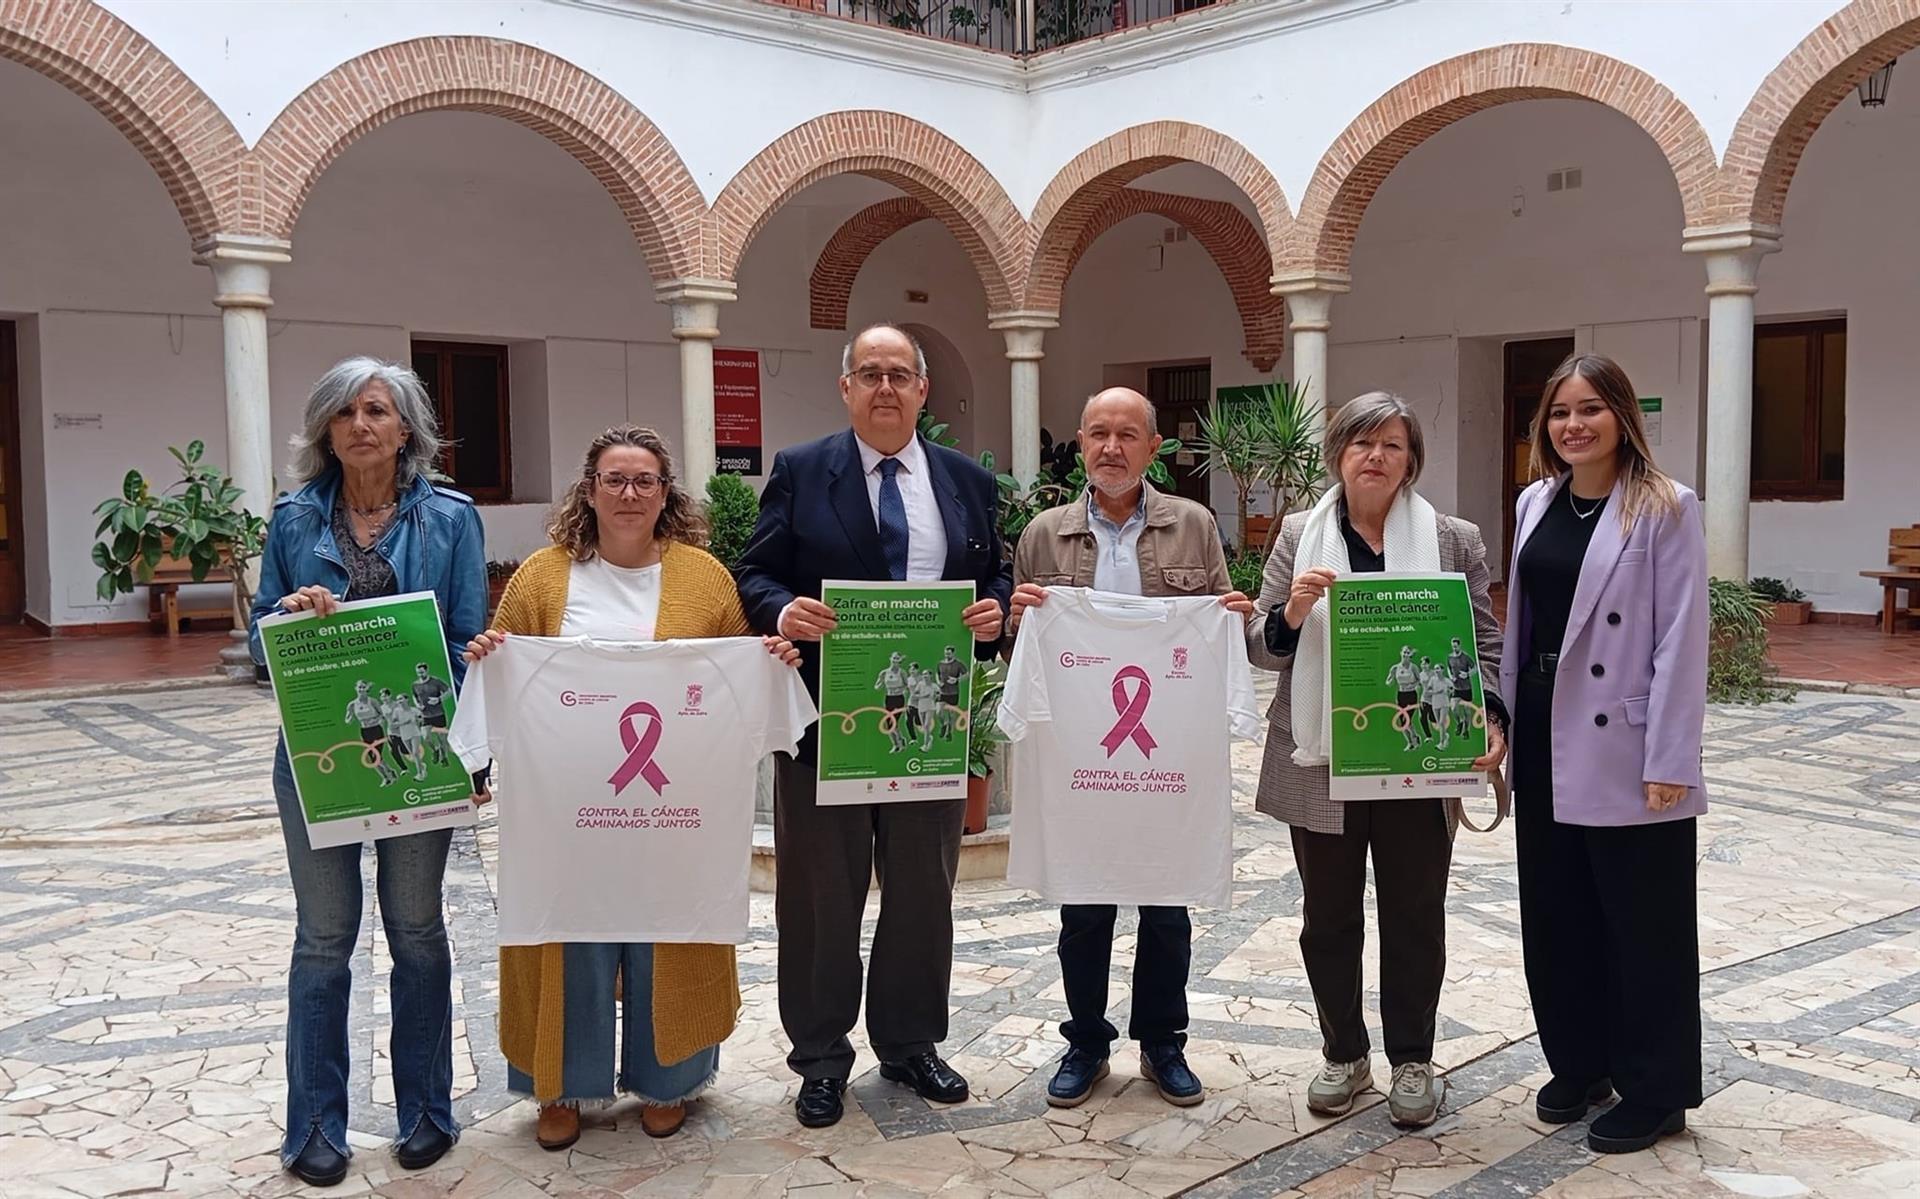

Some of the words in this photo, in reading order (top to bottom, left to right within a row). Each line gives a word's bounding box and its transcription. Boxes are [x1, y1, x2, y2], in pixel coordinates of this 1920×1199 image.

[1339, 590, 1373, 602] Zafra
[1377, 592, 1392, 600] en
[1395, 588, 1439, 600] marcha
[833, 598, 868, 609] Zafra
[871, 600, 887, 609] en
[891, 598, 939, 609] marcha
[1339, 605, 1382, 615] contra
[1385, 602, 1397, 613] el
[1400, 602, 1440, 613] cáncer
[878, 611, 890, 622] el
[894, 611, 938, 622] cáncer
[275, 629, 316, 645] Zafra
[318, 626, 337, 637] en
[341, 616, 397, 634] marcha
[278, 641, 328, 658] contra
[330, 637, 344, 649] el
[347, 629, 399, 647] cáncer
[283, 669, 292, 677] 19
[294, 666, 305, 675] de
[1073, 769, 1119, 780] CONTRA
[1123, 771, 1136, 781] EL
[1140, 769, 1185, 782] CÁNCER
[1071, 781, 1139, 792] CAMINAMOS
[1142, 783, 1187, 793] JUNTOS
[578, 807, 629, 817] CONTRA
[633, 808, 648, 817] EL
[651, 805, 700, 817] CÁNCER
[576, 819, 650, 829] CAMINAMOS
[653, 819, 701, 829] JUNTOS
